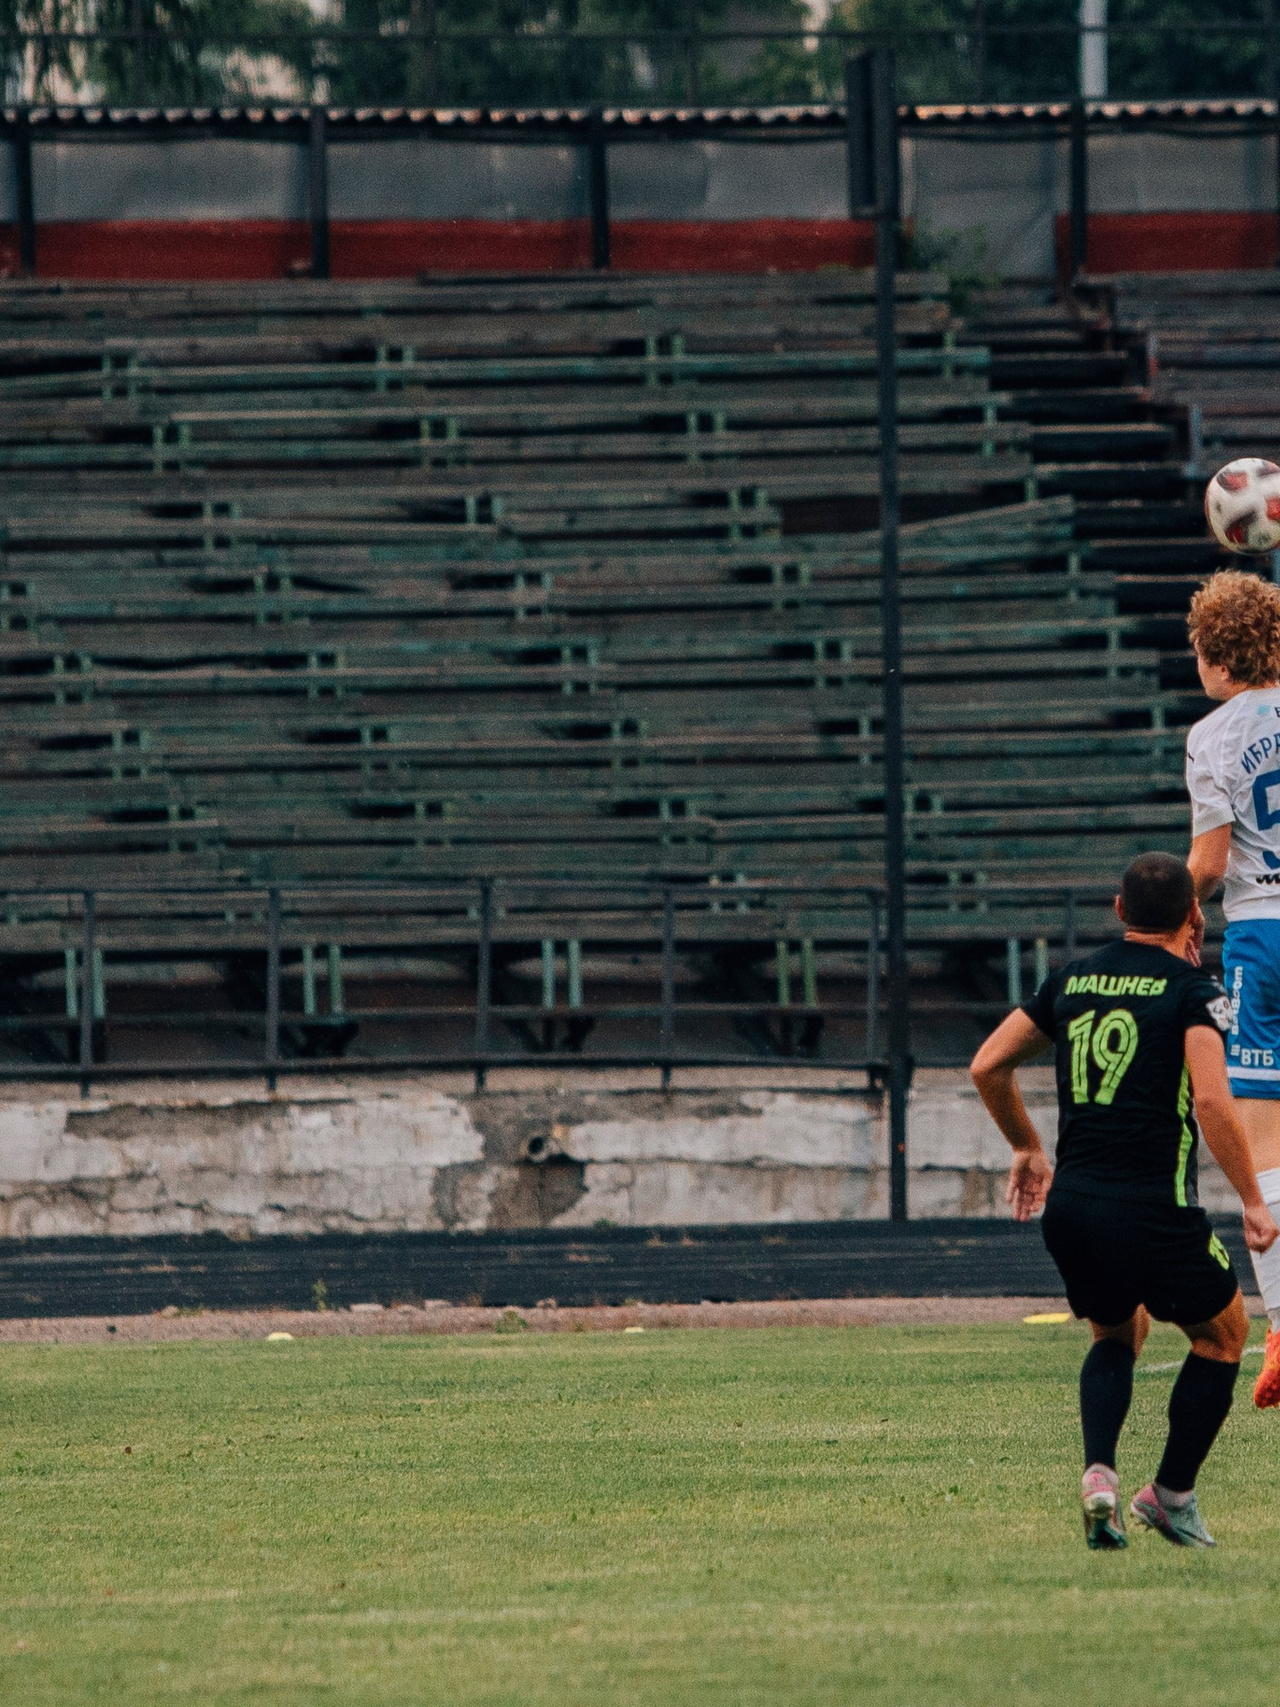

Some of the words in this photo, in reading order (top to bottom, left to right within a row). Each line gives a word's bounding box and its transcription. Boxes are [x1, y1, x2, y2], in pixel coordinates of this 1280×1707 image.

[1065, 974, 1168, 996] МАШНЕВ
[1067, 1008, 1139, 1105] 19
[1240, 1047, 1275, 1067] ВТБ
